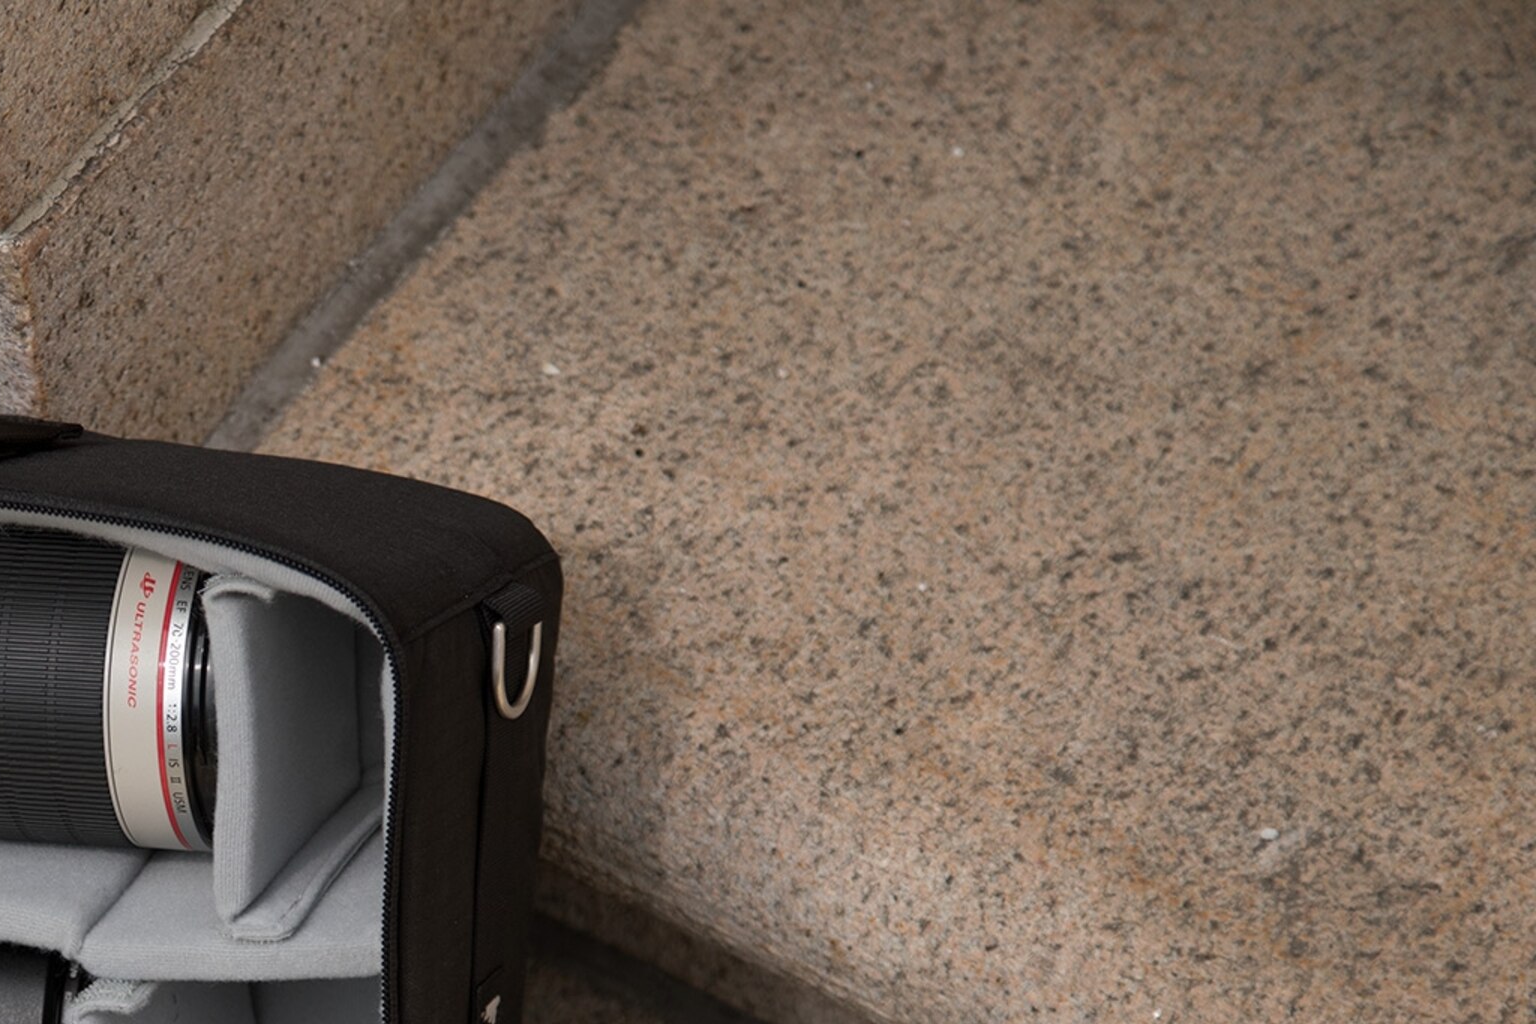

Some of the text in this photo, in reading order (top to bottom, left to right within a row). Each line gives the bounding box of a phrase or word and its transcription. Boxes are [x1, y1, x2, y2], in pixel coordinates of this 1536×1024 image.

[176, 600, 189, 614] EF
[126, 600, 147, 709] ULTRASONIC
[167, 758, 180, 768] IS
[171, 791, 187, 814] USM
